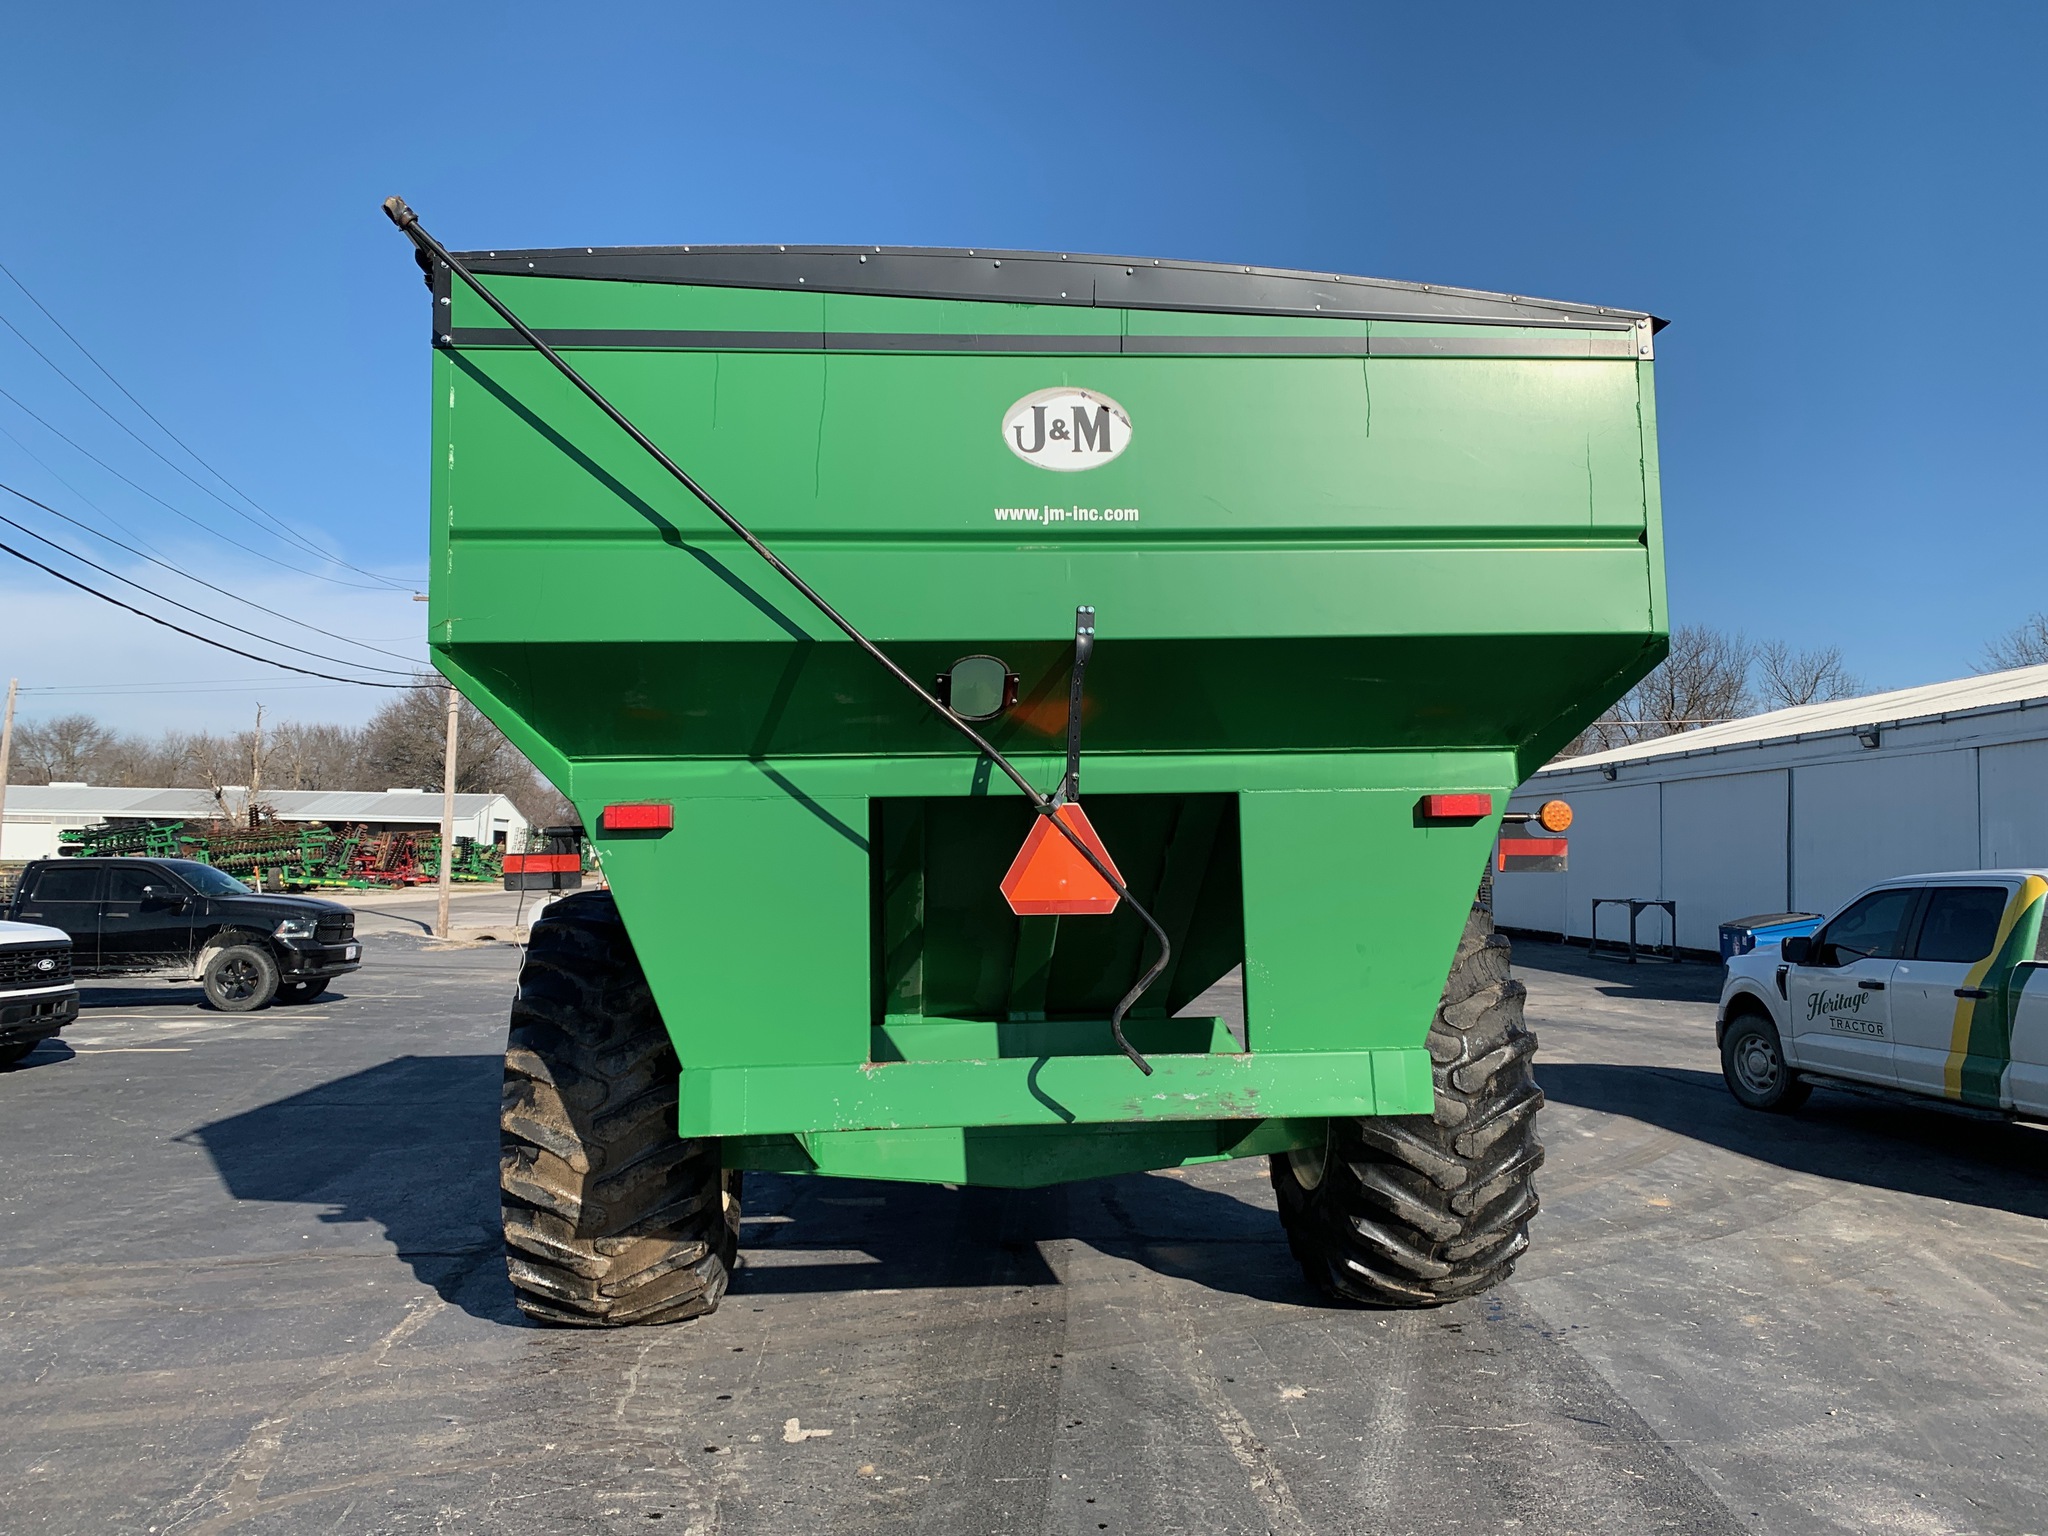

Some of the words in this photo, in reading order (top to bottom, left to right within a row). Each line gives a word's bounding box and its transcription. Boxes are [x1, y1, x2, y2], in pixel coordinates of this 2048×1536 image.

[1013, 406, 1113, 453] J&M
[994, 505, 1139, 525] www.jm-inc.com
[1806, 989, 1869, 1021] Heritage
[1829, 1017, 1884, 1035] TRACTOR
